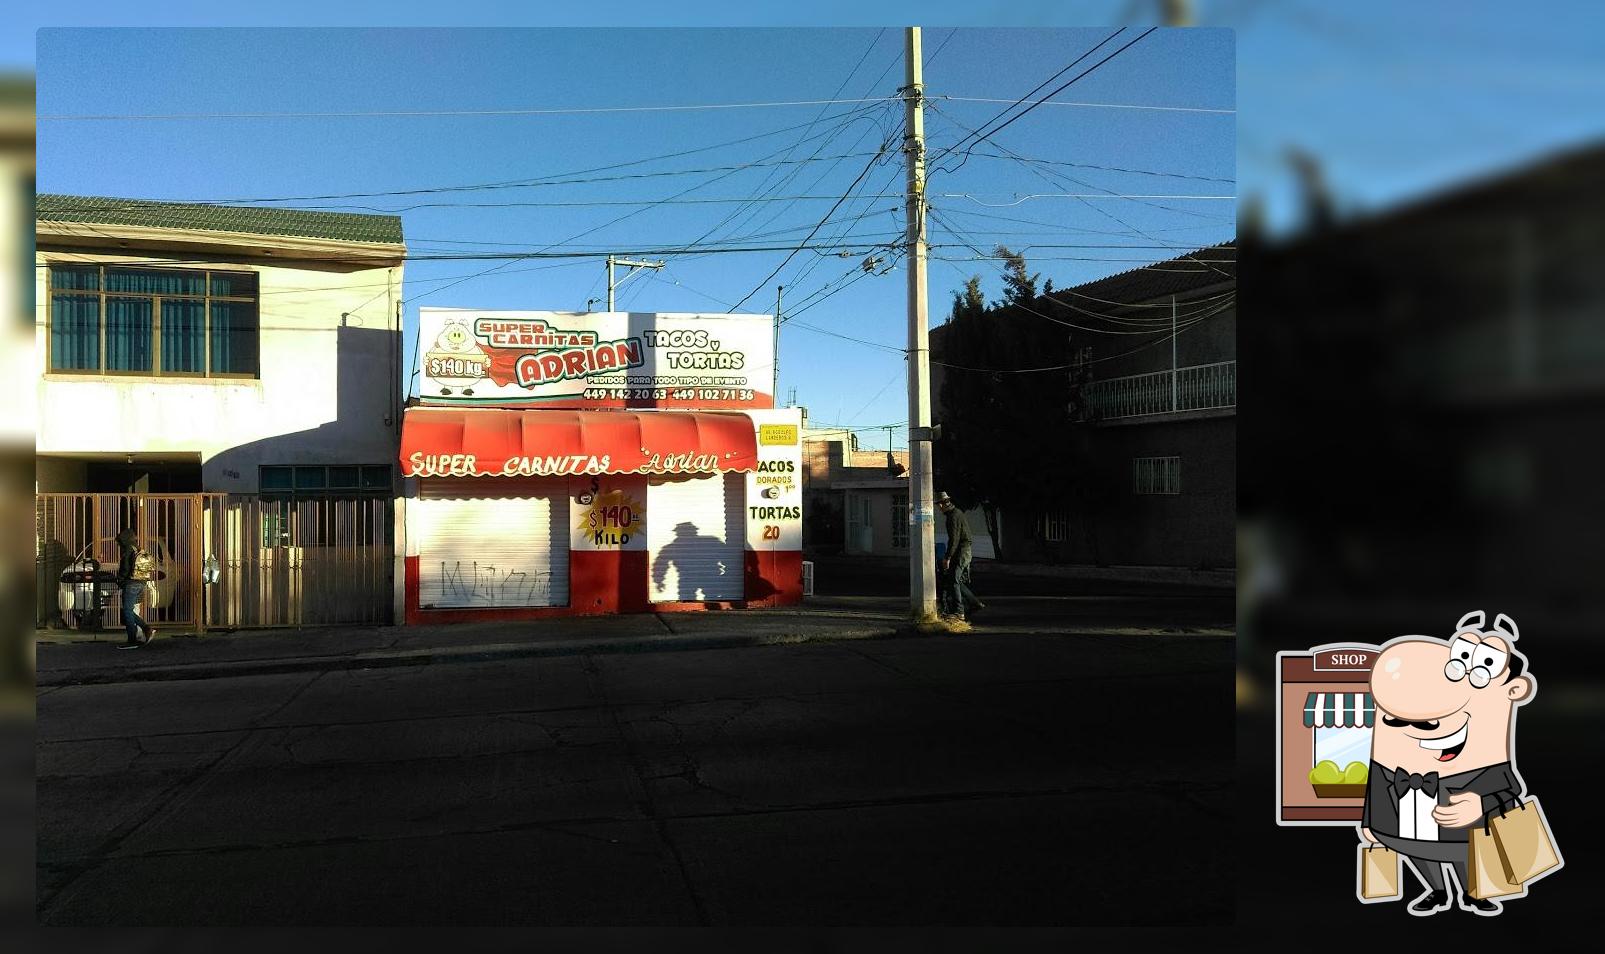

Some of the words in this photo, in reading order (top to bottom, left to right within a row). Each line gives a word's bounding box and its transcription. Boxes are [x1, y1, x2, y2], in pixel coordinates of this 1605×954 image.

[479, 322, 545, 334] SUPER
[643, 330, 709, 348] TACOS
[520, 341, 640, 383] ADRIAN
[666, 351, 744, 369] TORTAS
[587, 376, 625, 385] PEDIDOS
[627, 376, 651, 385] PARA
[653, 376, 677, 385] TODO
[678, 376, 699, 385] TIPO
[700, 376, 713, 385] DE
[714, 376, 748, 386] EVENTO
[583, 389, 607, 400] 449
[610, 389, 631, 400] 142
[634, 389, 650, 400] 20
[652, 389, 667, 400] 63
[672, 389, 695, 400] 449
[699, 389, 719, 400] 102
[723, 389, 736, 400] 71
[740, 389, 754, 400] 36
[409, 452, 477, 473] SUPER
[503, 455, 611, 474] CARNITAS
[757, 460, 795, 473] ACOS
[756, 476, 792, 485] DORADOS
[749, 506, 801, 520] TORTAS
[594, 529, 630, 546] KILO
[763, 525, 780, 540] 20
